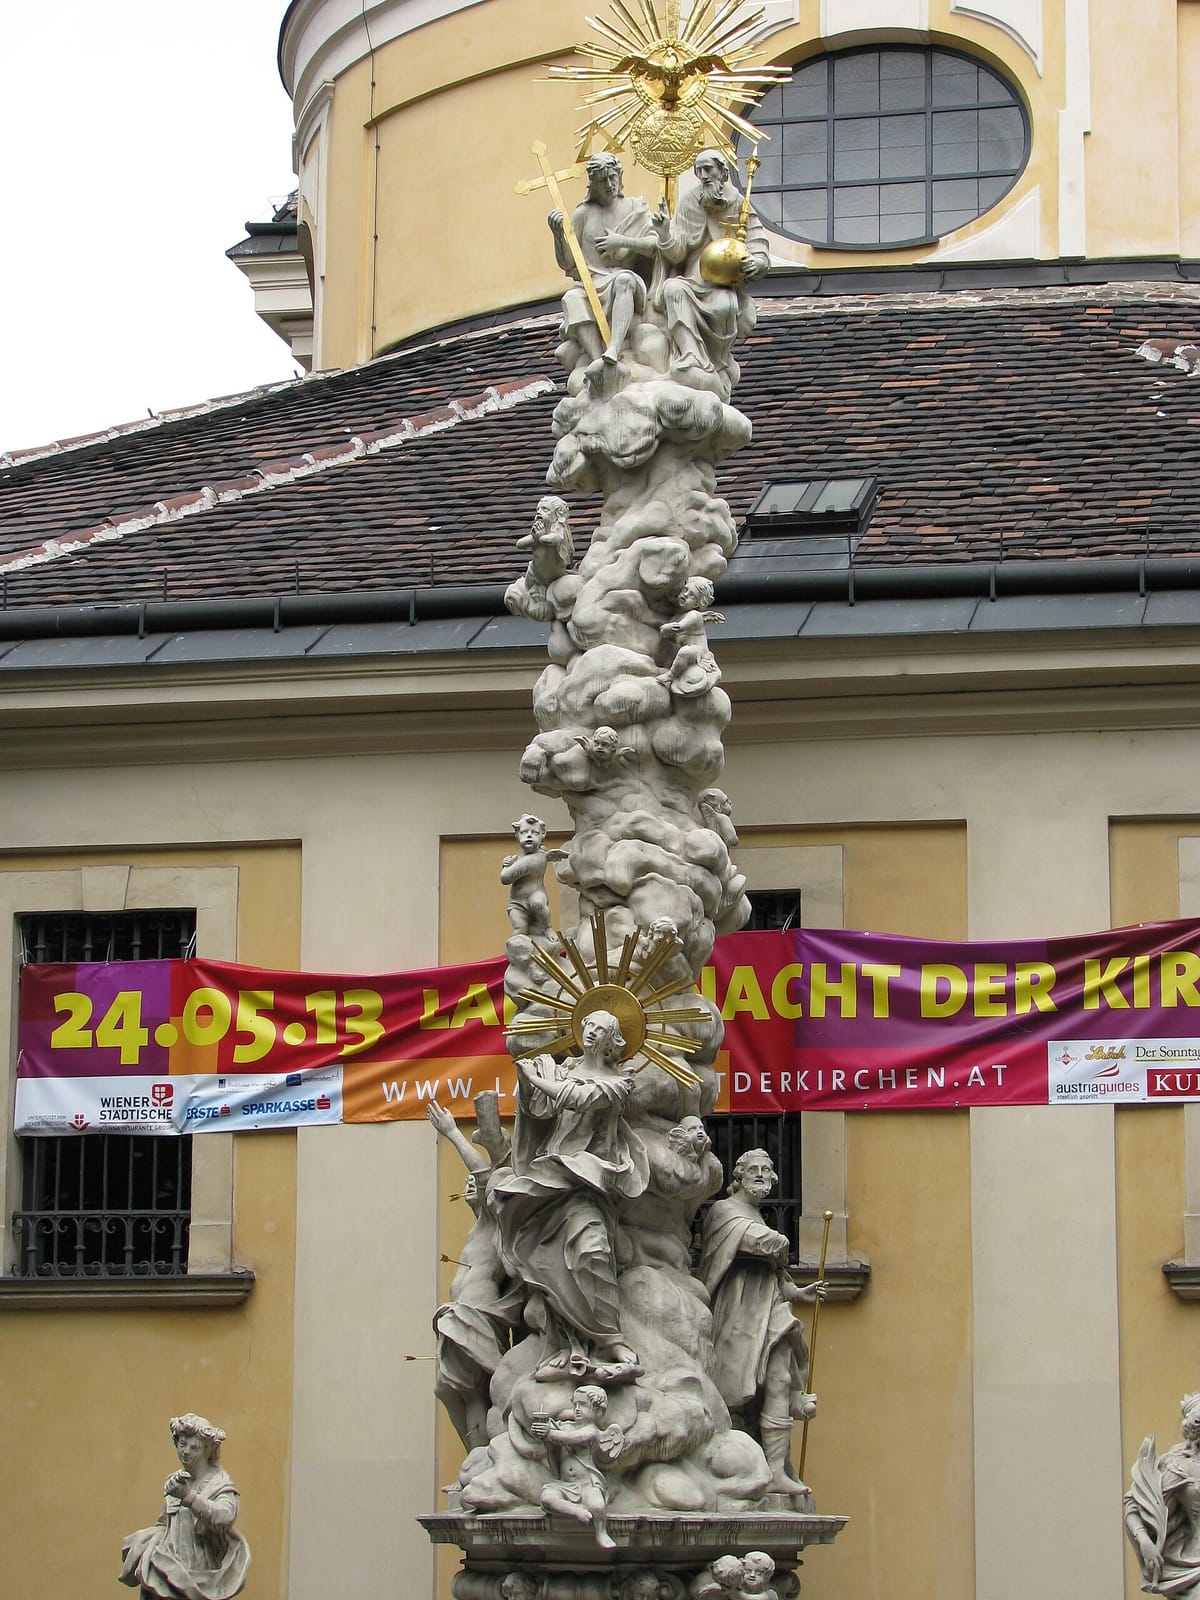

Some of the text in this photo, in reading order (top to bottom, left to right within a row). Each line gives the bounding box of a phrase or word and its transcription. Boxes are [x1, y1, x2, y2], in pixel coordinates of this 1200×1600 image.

[50, 987, 386, 1065] 24.05.13
[920, 962, 1059, 1019] DER
[1083, 950, 1200, 1010] KIR
[1135, 1046, 1157, 1058] Der
[1056, 1082, 1140, 1095] austriaguides
[100, 1096, 150, 1108] WIENER
[241, 1099, 316, 1116] SPARKASSE
[99, 1108, 173, 1121] STÄDTISCHE
[186, 1106, 219, 1120] ERSTE
